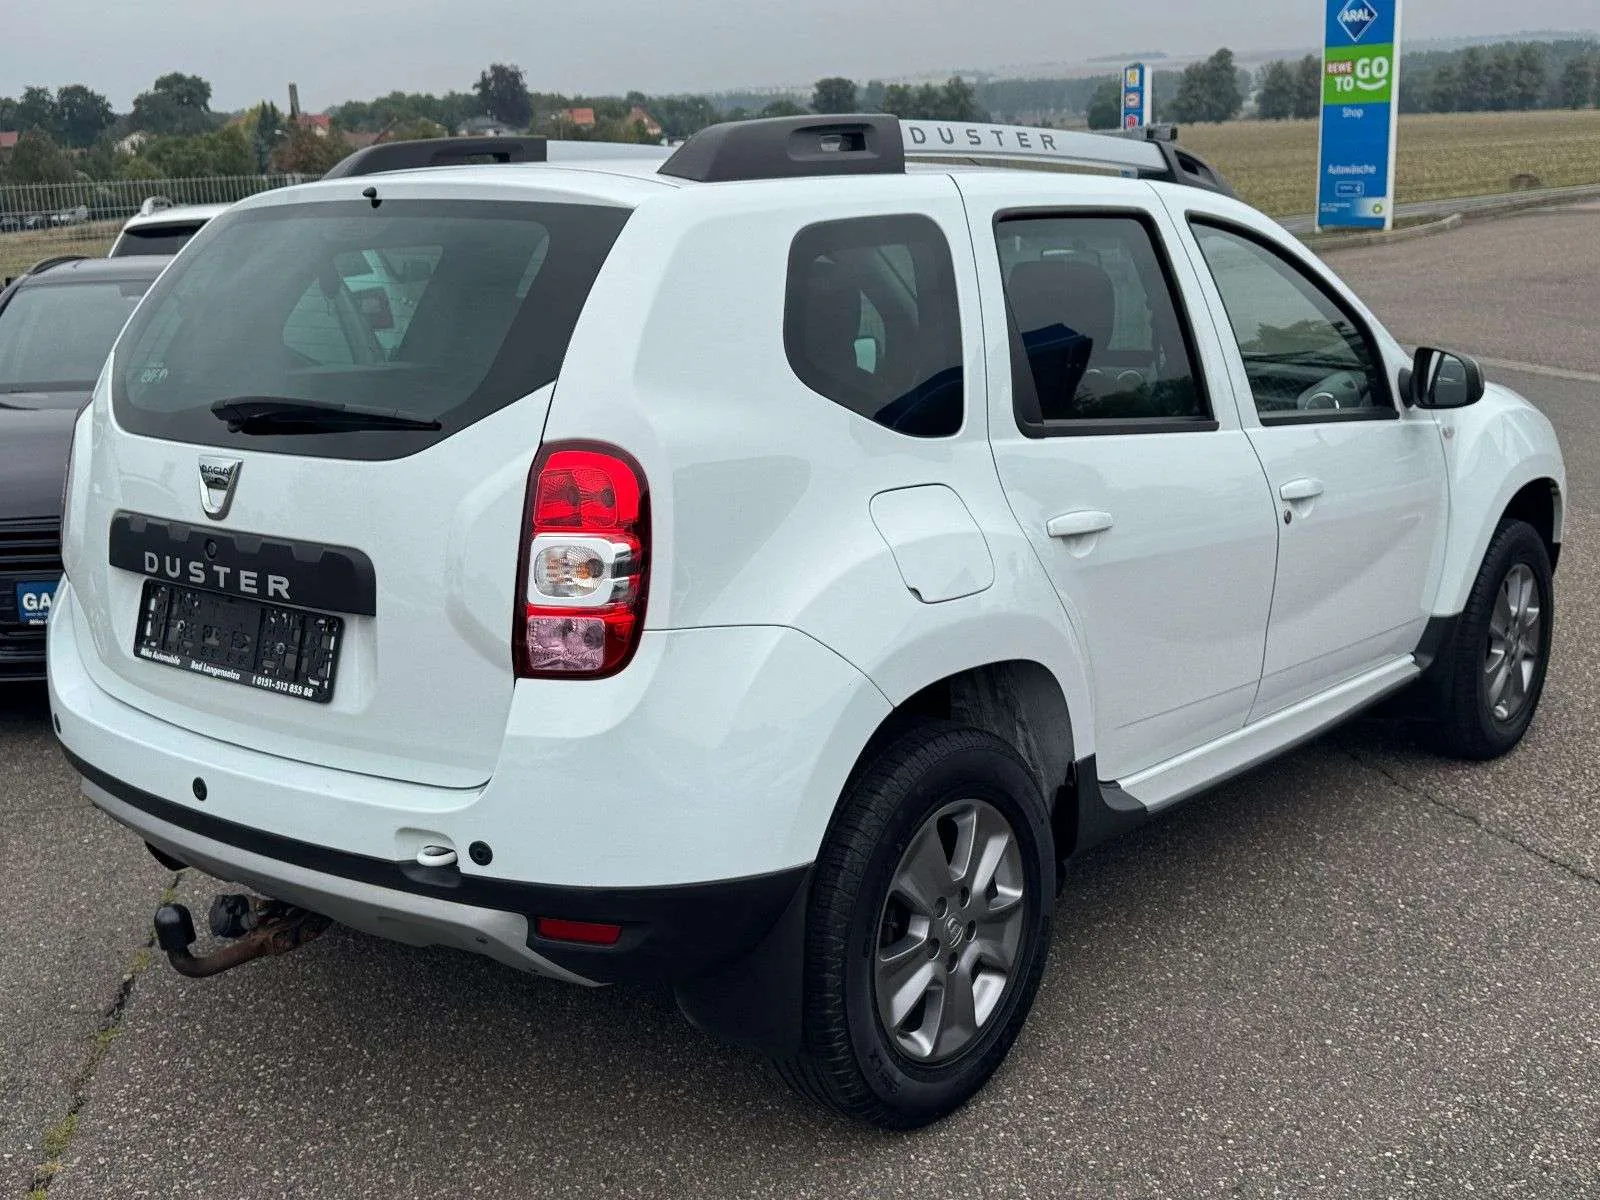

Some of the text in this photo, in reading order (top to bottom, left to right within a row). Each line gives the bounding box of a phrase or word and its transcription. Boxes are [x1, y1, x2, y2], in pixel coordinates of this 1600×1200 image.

[1342, 8, 1370, 22] ARAL
[1334, 56, 1389, 92] TO GO
[908, 126, 1057, 150] DUSTER
[200, 464, 230, 476] DACIA
[143, 551, 291, 600] DUSTER
[191, 660, 203, 671] Bad
